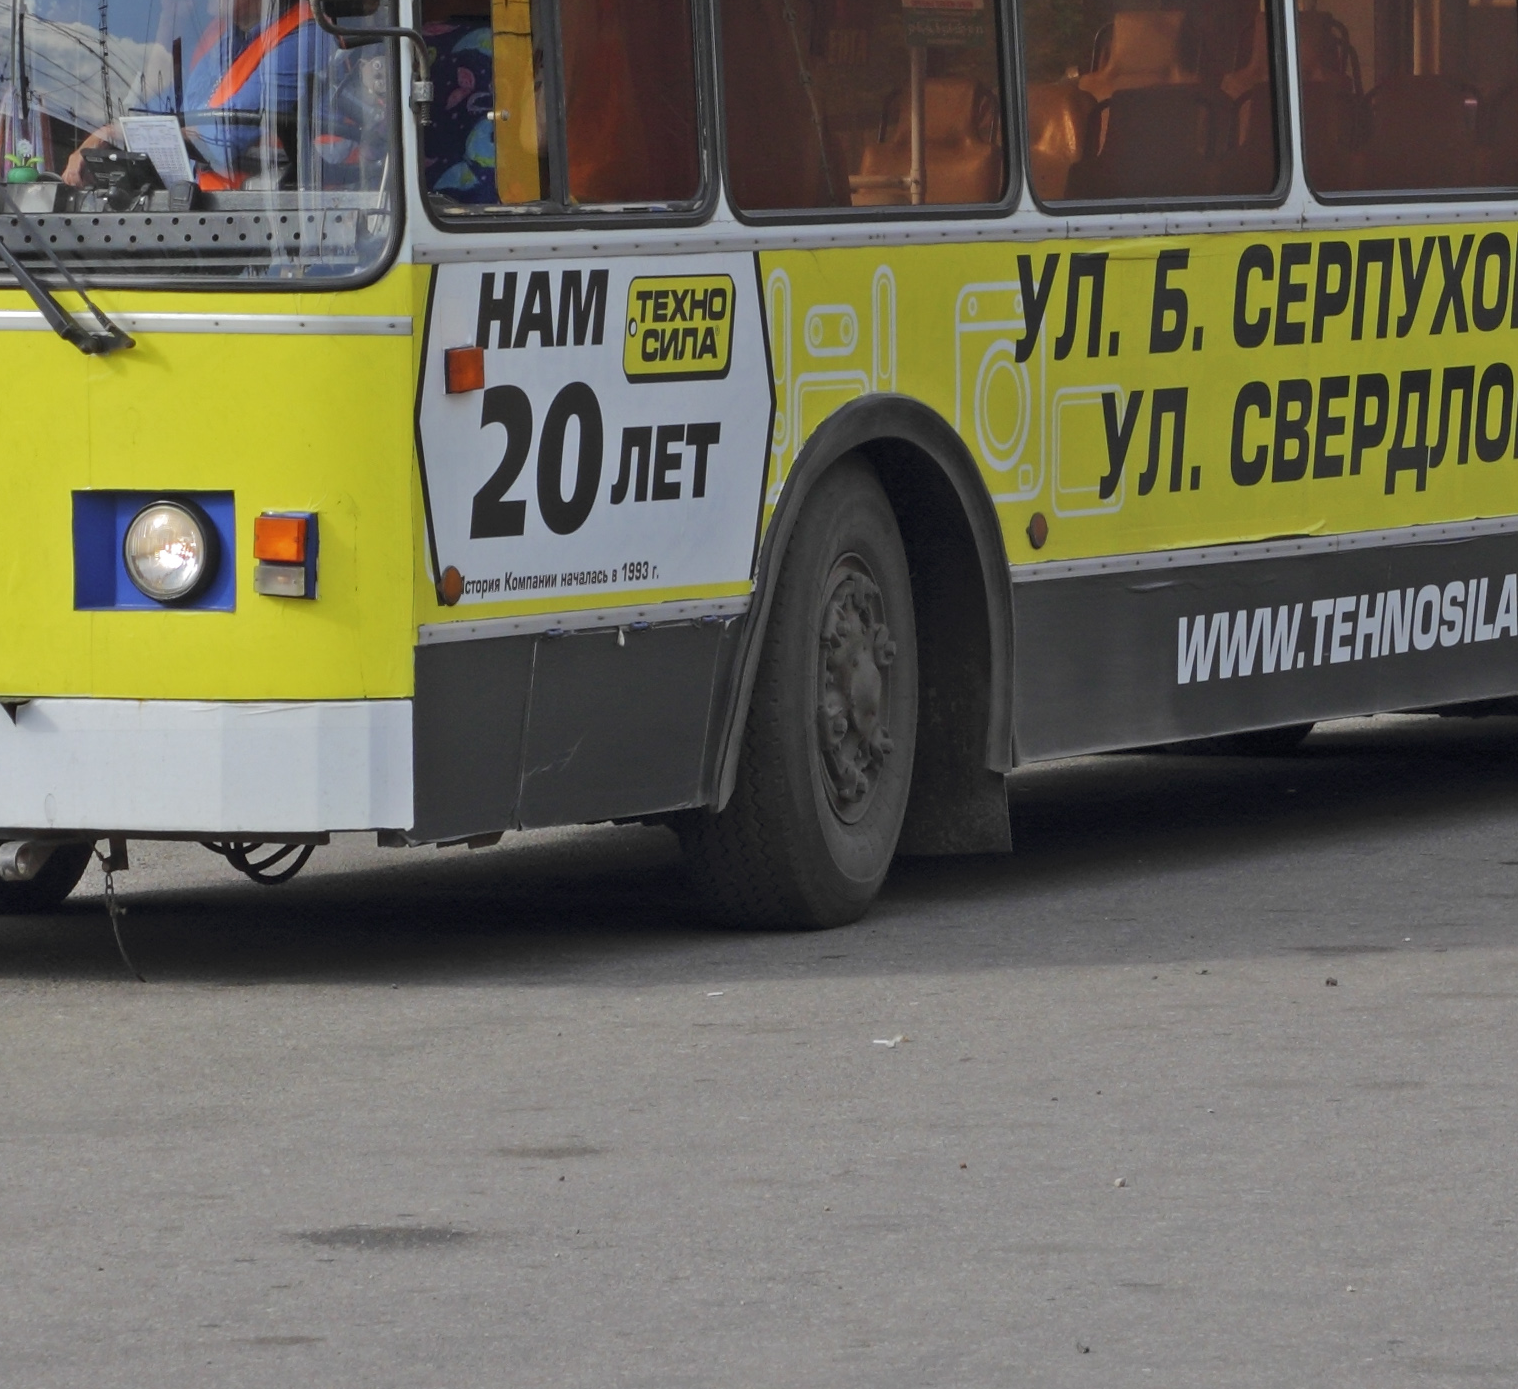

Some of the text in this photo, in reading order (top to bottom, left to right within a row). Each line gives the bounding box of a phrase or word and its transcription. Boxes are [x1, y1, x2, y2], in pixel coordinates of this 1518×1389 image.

[476, 269, 609, 349] НАМ
[635, 287, 727, 323] ТЕХНО
[641, 326, 718, 362] СИЛА
[1015, 253, 1120, 363] УЛ.
[1149, 248, 1204, 354] Б.
[469, 381, 721, 540] 20 ЛЕТ
[1098, 386, 1201, 500] УЛ.
[504, 571, 557, 593] Компании
[560, 569, 608, 587] началась
[611, 568, 617, 583] в
[621, 561, 649, 582] 1993
[651, 564, 660, 580] г.
